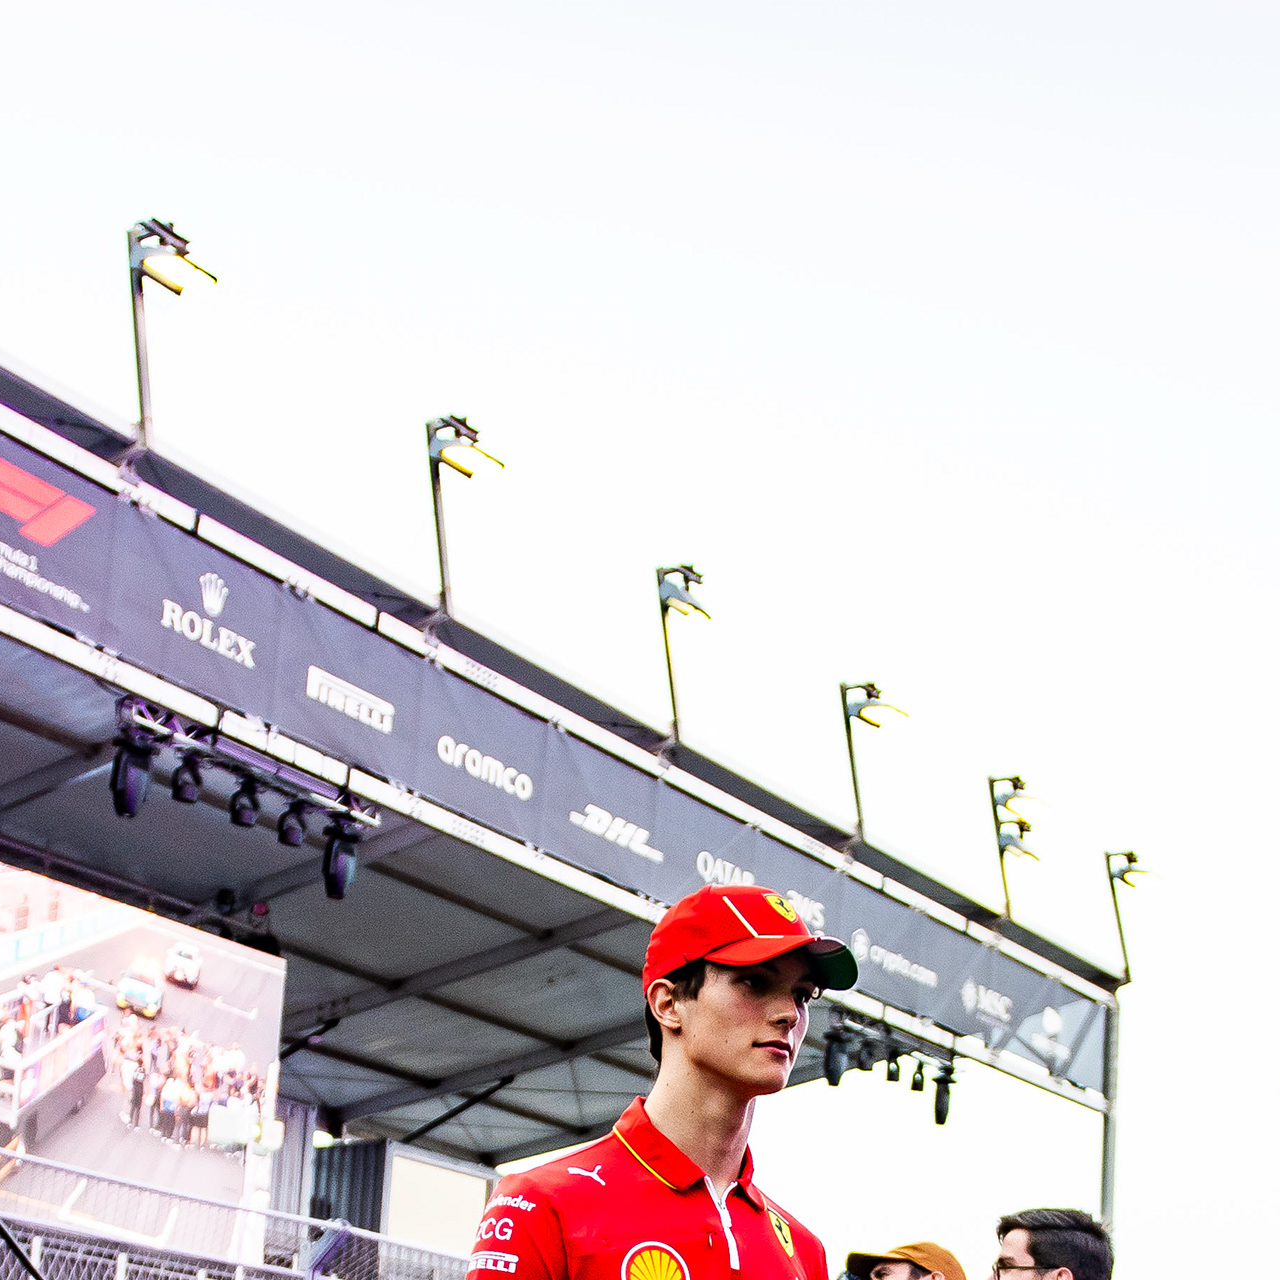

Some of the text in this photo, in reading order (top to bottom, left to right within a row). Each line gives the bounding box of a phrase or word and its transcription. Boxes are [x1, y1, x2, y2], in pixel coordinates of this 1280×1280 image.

[161, 598, 258, 670] ROLEX
[306, 664, 396, 735] PIRELLI
[436, 735, 534, 802] aramco
[570, 803, 663, 864] DHL
